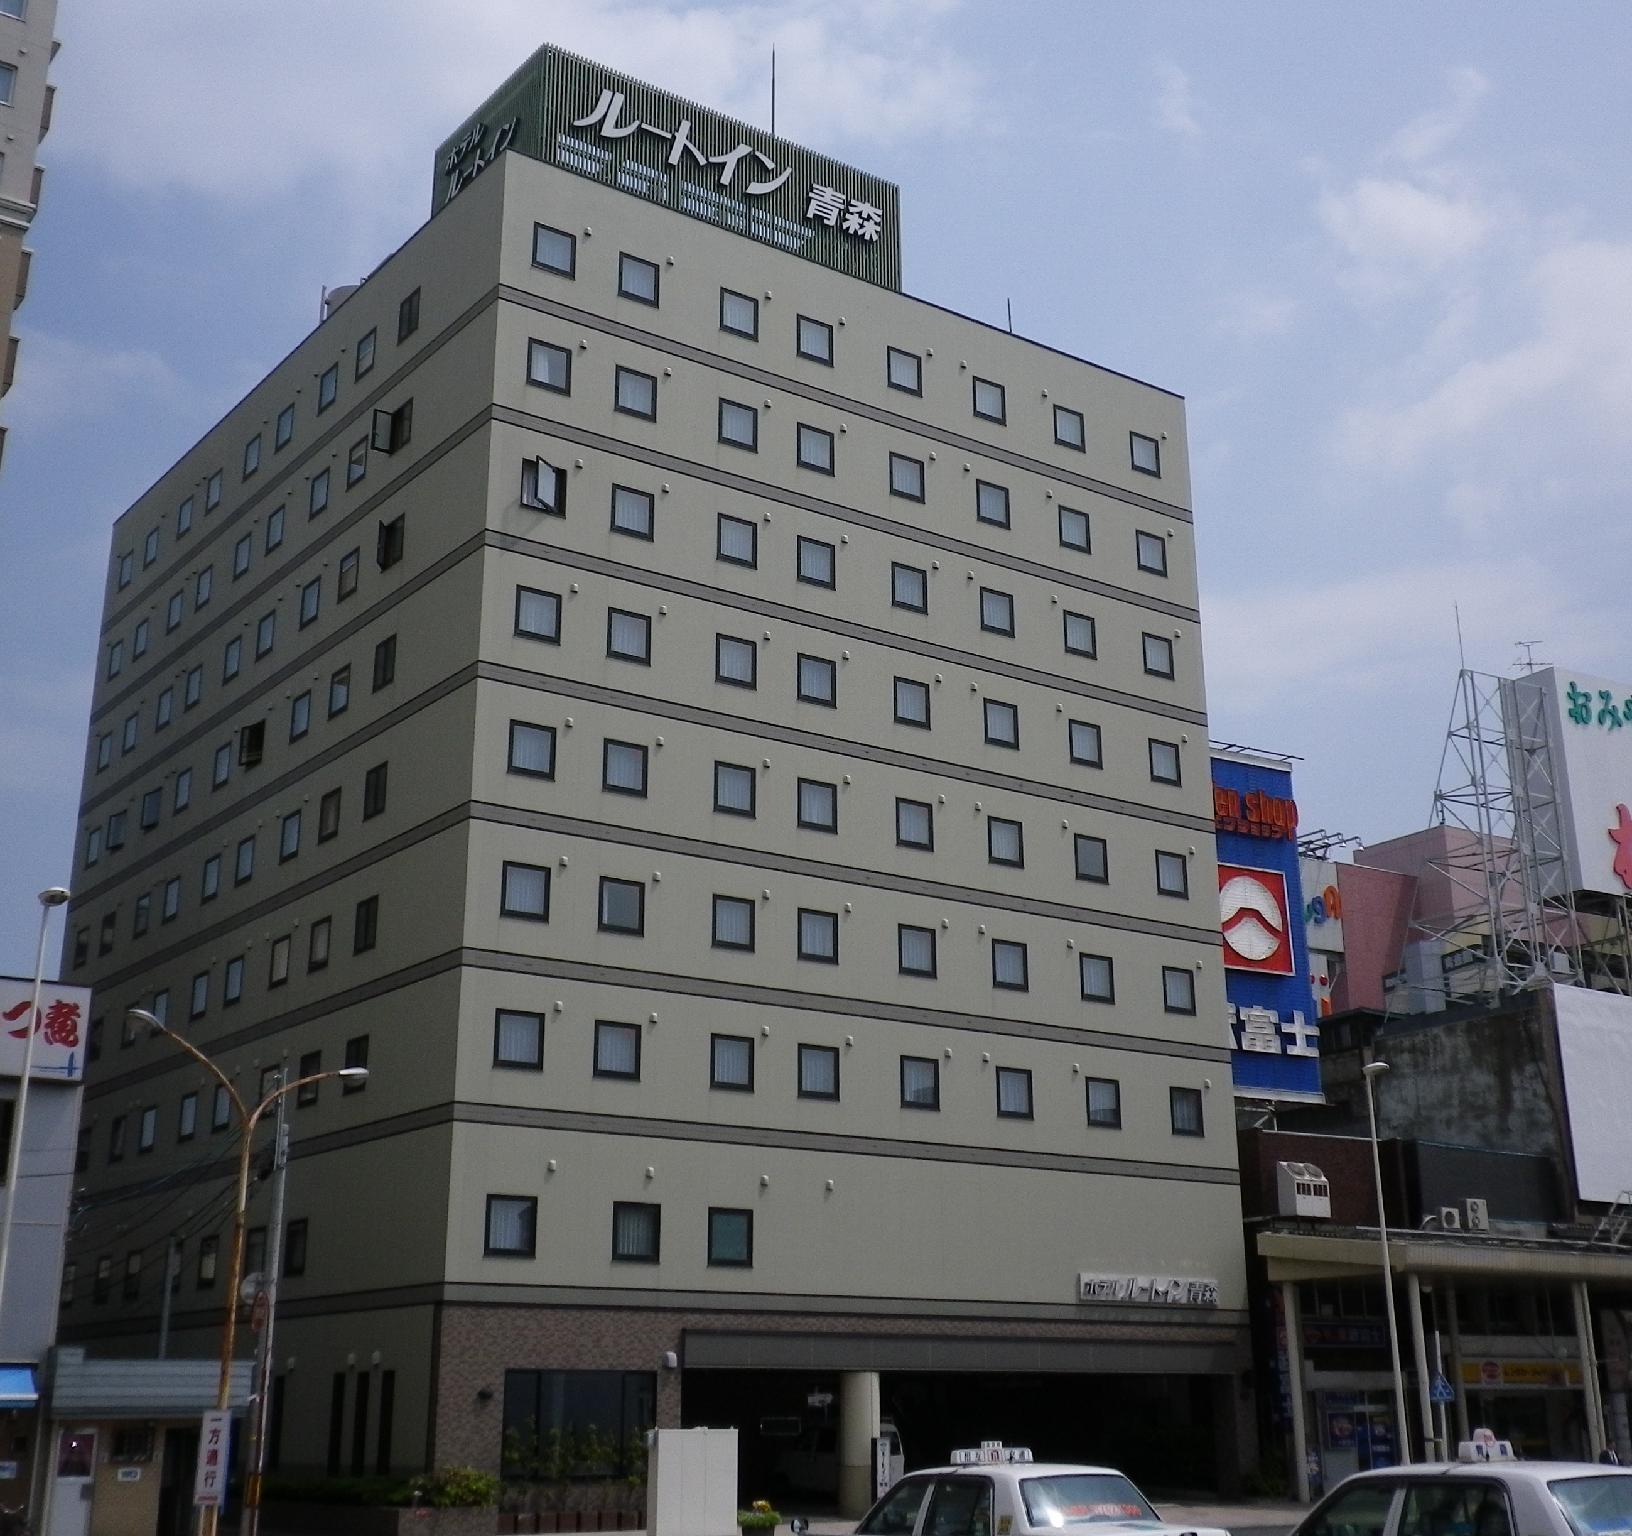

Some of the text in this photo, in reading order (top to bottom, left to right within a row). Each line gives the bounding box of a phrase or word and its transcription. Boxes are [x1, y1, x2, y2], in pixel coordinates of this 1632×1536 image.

[445, 124, 484, 170] ホテル
[573, 89, 883, 242] ルートイン 青森
[1227, 1002, 1320, 1058] 富士
[204, 1417, 222, 1489] 一方通行
